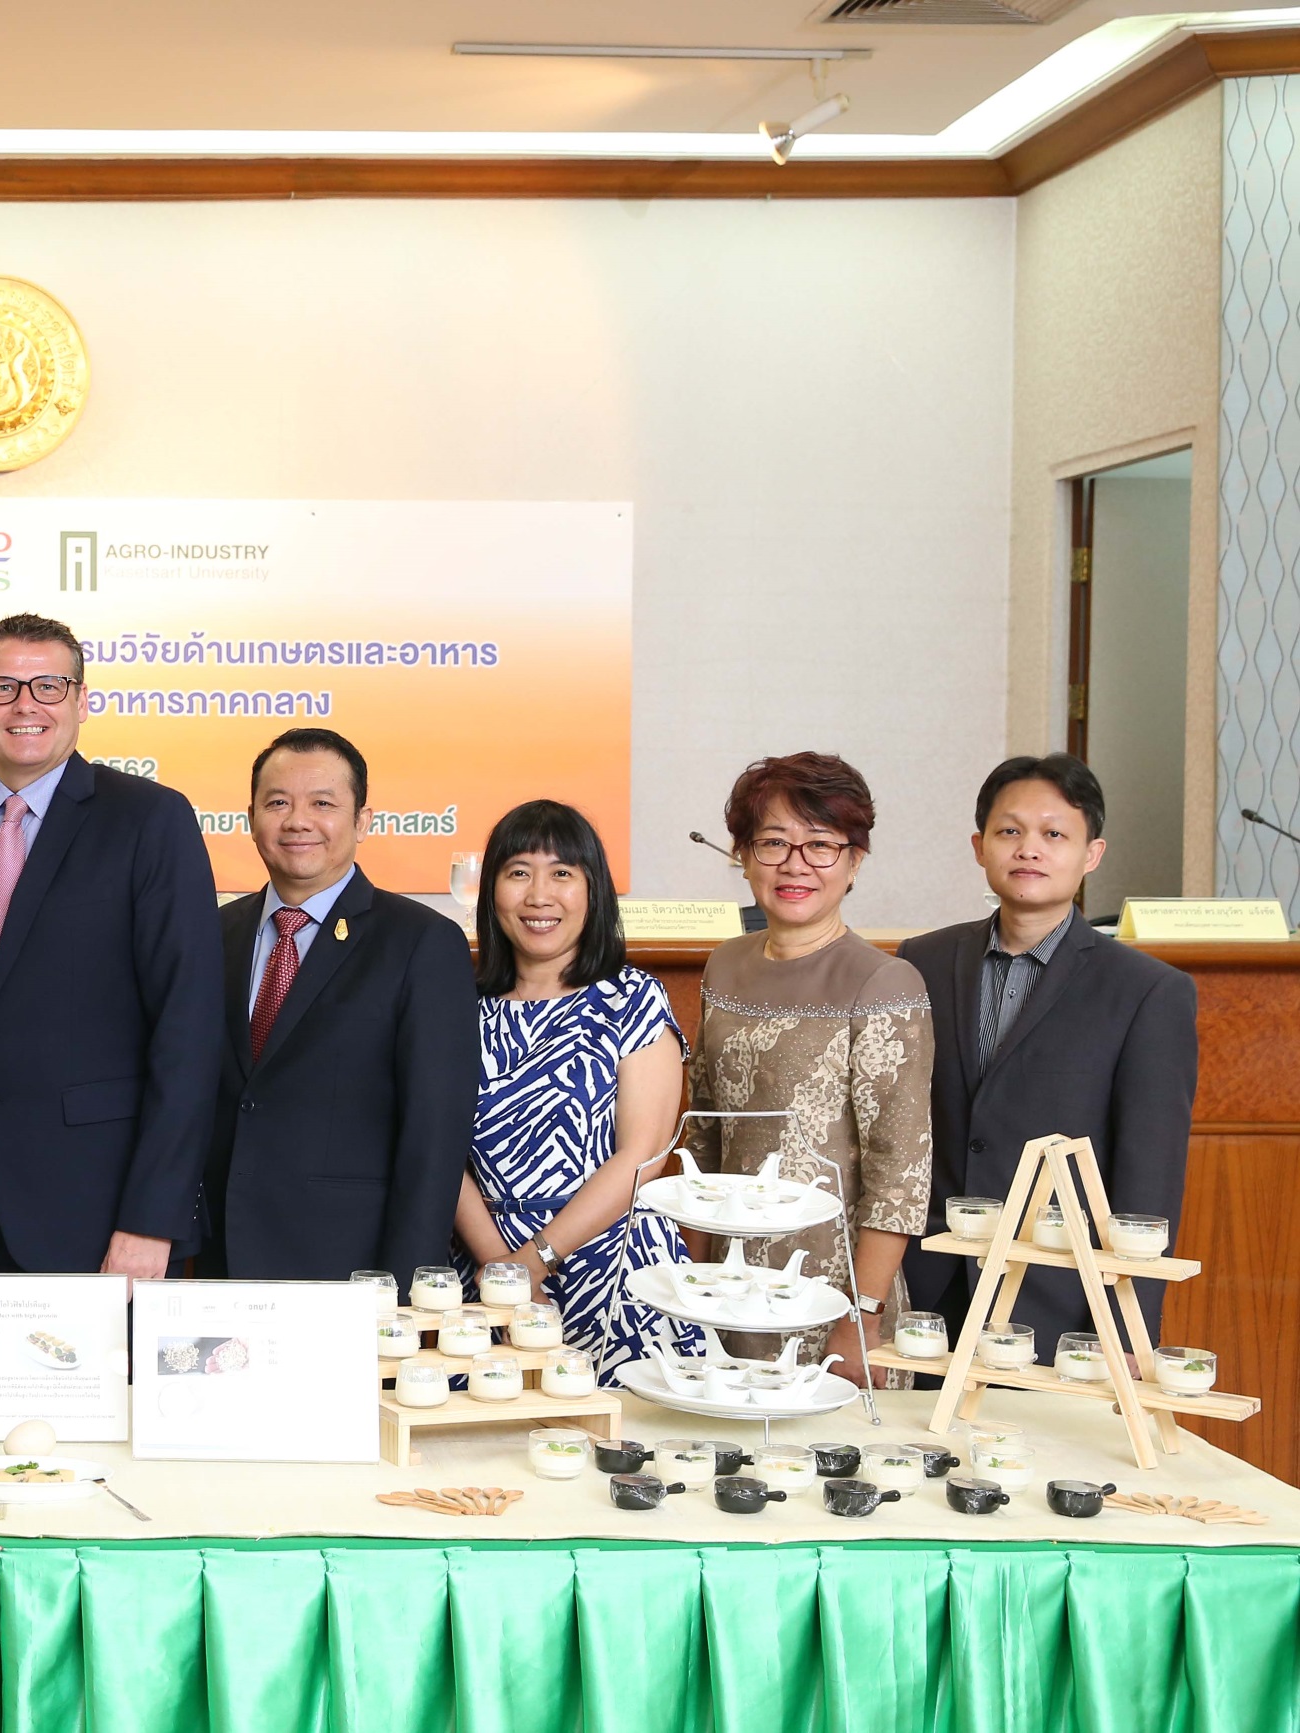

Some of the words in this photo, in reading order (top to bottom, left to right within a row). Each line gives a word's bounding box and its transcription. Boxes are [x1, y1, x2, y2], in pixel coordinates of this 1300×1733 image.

[105, 543, 269, 560] AGRO-INDUSTRY
[189, 565, 270, 582] University
[91, 759, 156, 780] 562
